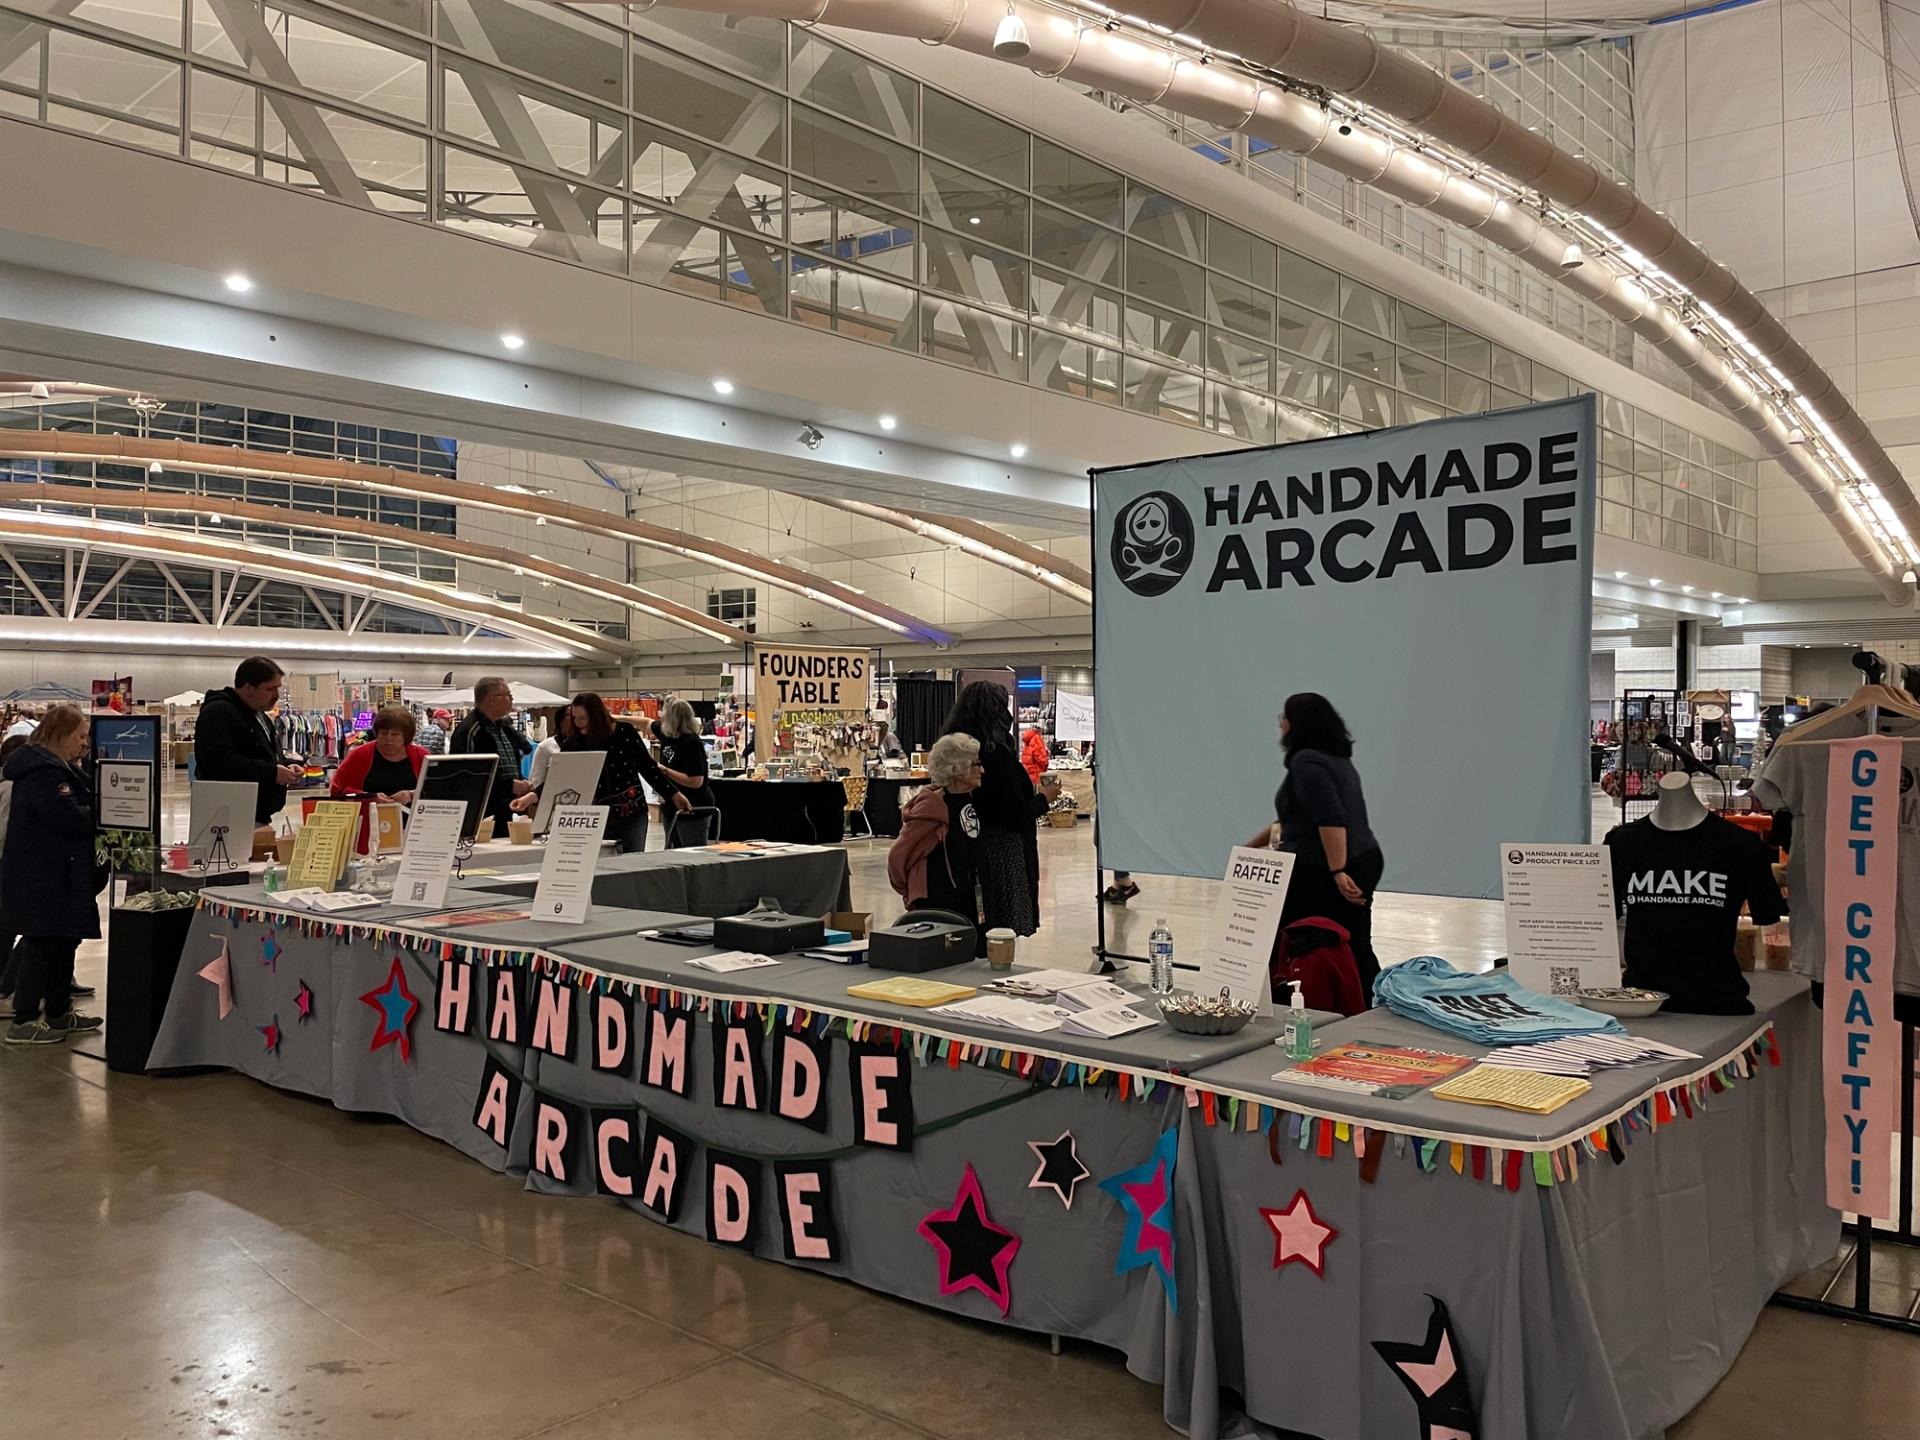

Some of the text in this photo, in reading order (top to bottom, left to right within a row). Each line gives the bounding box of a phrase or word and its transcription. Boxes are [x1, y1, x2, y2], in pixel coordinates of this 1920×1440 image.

[1204, 432, 1578, 526] HANDMADE
[1205, 491, 1577, 593] ARCADE
[759, 653, 864, 679] FOUNDERS
[777, 680, 840, 704] TABLE
[558, 817, 600, 828] RAFFLE
[1232, 863, 1282, 885] RAFFLE
[1627, 870, 1728, 899] MAKE
[1637, 895, 1725, 908] HANDMADE ARCADE
[1841, 749, 1878, 1194] GET CRAFTY!
[438, 961, 898, 1146] HANDMADE
[477, 1071, 831, 1260] ARCADE
